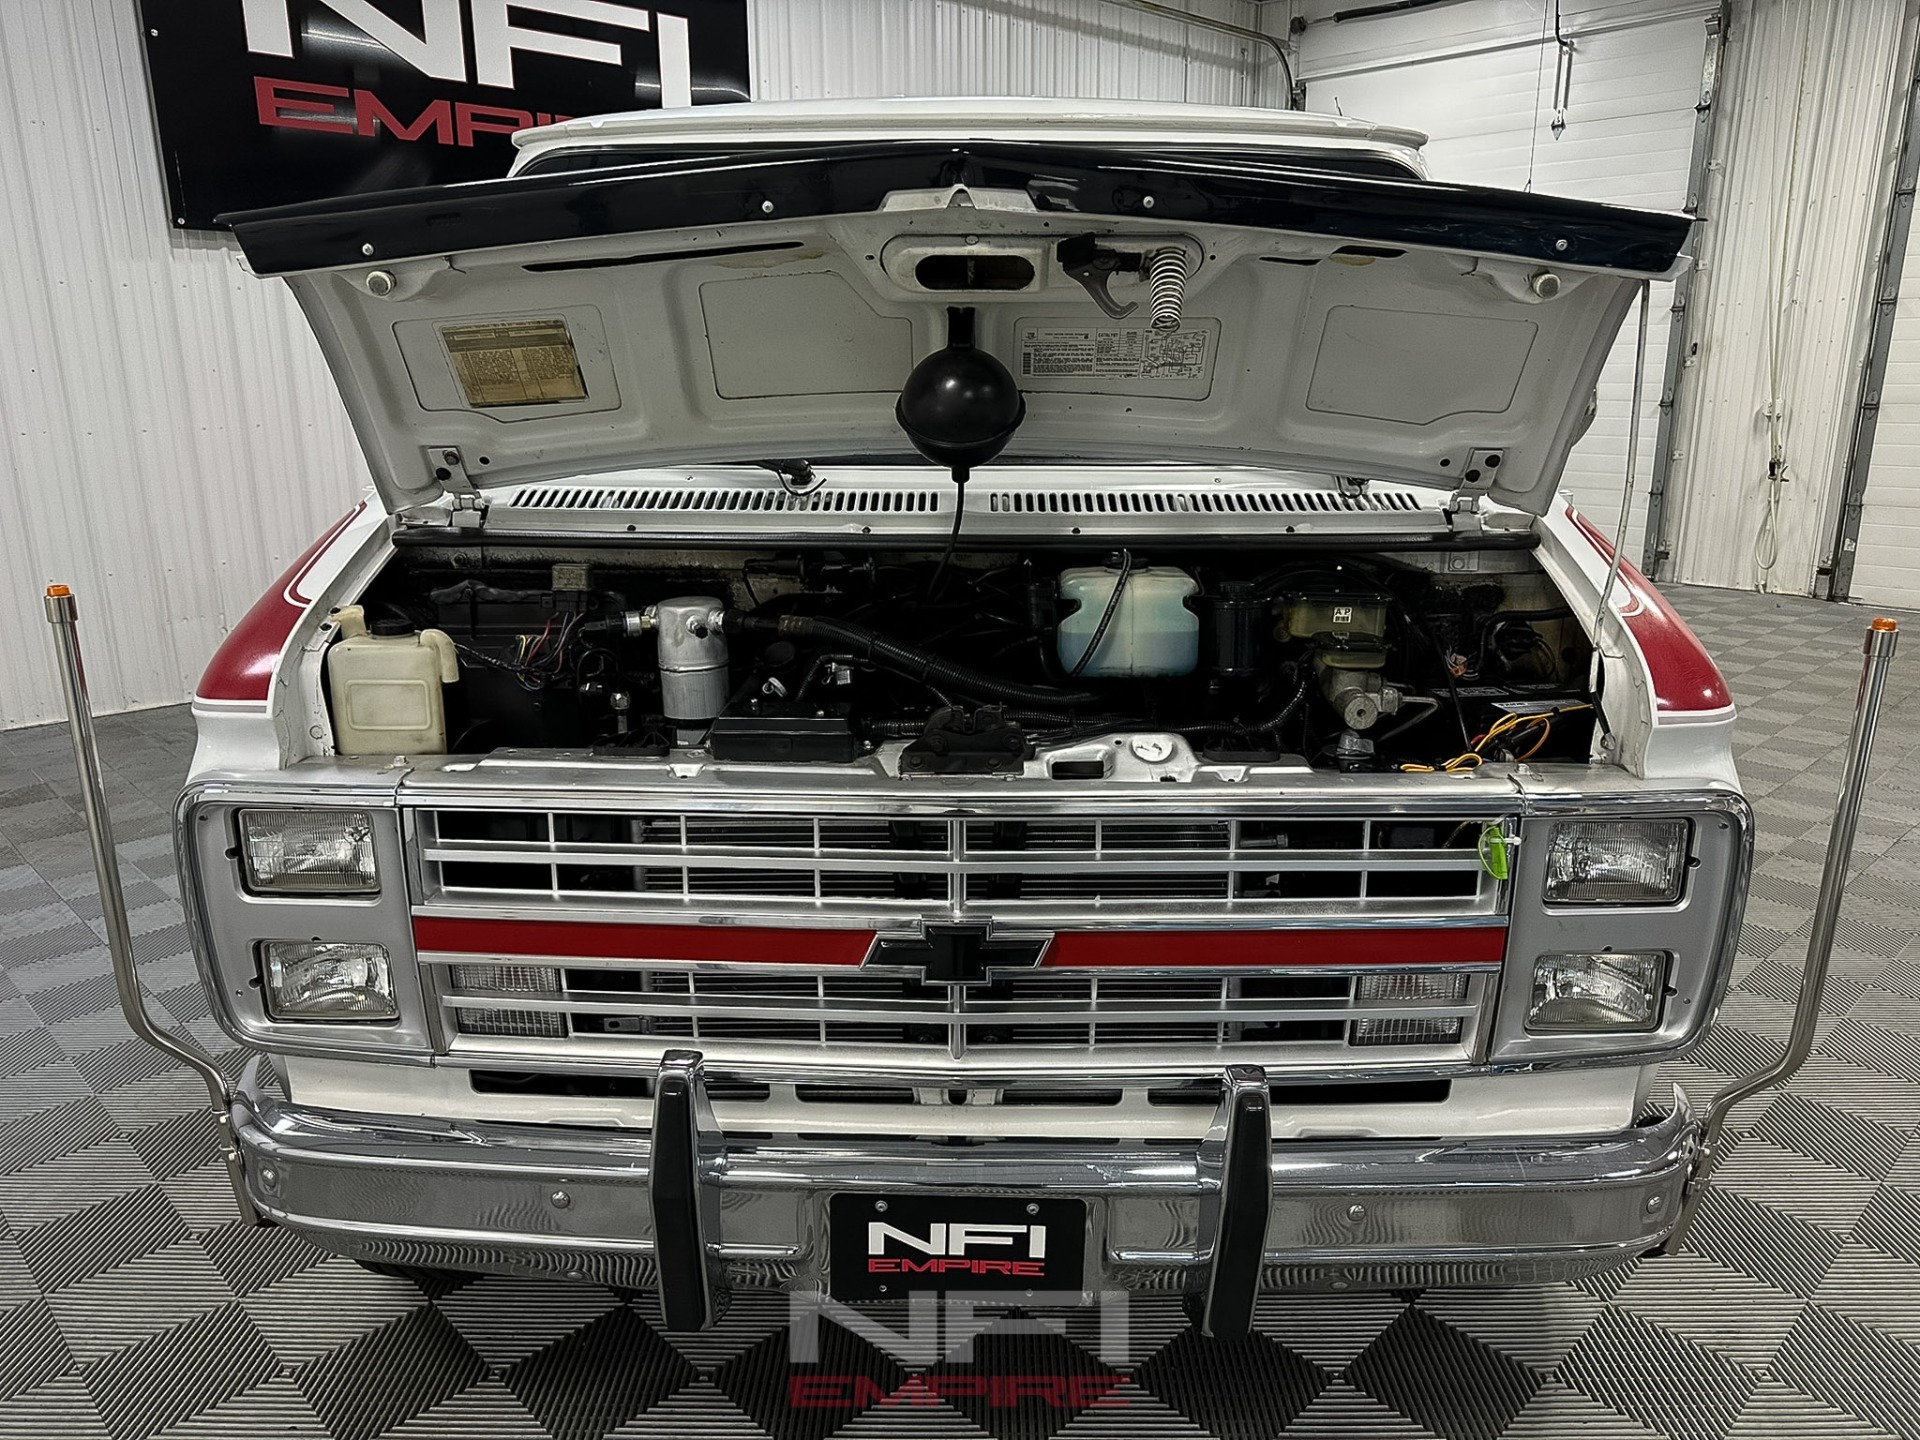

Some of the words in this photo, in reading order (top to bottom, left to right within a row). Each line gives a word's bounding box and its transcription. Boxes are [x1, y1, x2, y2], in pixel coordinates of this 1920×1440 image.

[253, 76, 576, 147] EMP
[868, 1221, 1046, 1258] NFI
[868, 1258, 1045, 1276] EMPIRE
